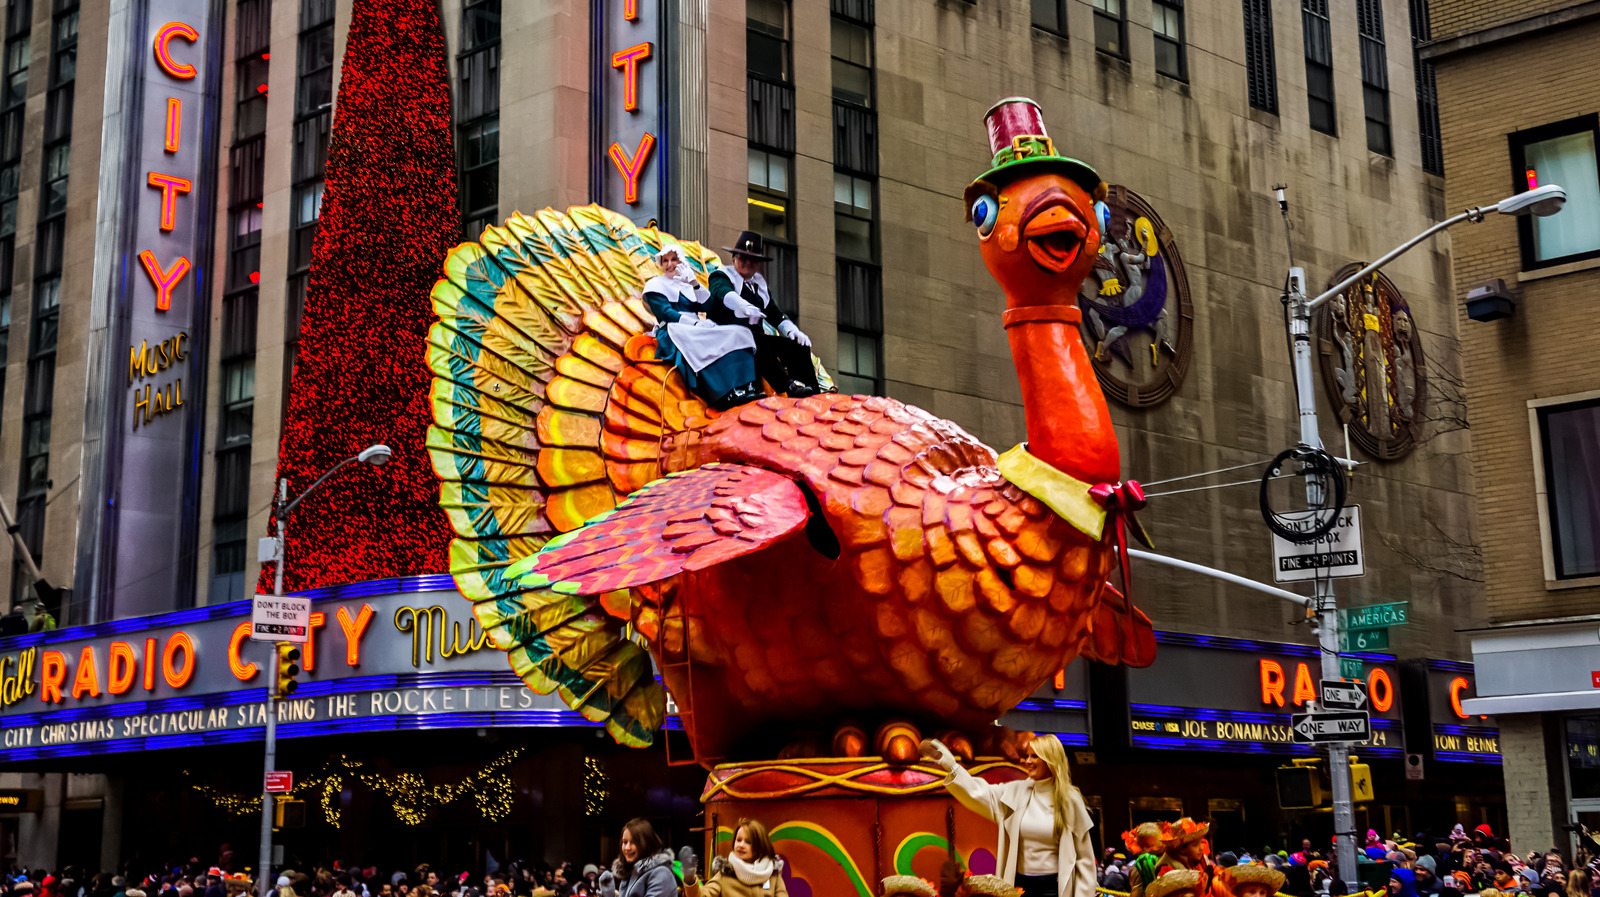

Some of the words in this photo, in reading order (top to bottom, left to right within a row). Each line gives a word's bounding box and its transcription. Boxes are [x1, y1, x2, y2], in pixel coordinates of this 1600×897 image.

[138, 21, 200, 311] CITY
[1281, 558, 1302, 570] FINE
[1321, 552, 1355, 566] POINTS
[257, 601, 279, 609] DON'T
[281, 602, 306, 611] BLOCK
[266, 610, 280, 619] THE
[282, 612, 298, 620] BOX
[1351, 609, 1406, 627] AMERICAS
[1357, 633, 1367, 648] 6
[41, 631, 195, 703] RADIO
[1326, 690, 1341, 701] ONE
[1347, 693, 1362, 702] WAY
[5, 727, 34, 748] CITY
[40, 719, 115, 745] CHRISTMAS
[122, 708, 228, 737] SPECTACULAR
[237, 698, 316, 726] STARING
[328, 694, 358, 718] THE
[371, 686, 532, 714] ROCKETTES
[1181, 719, 1208, 738] JOE
[1372, 730, 1387, 746] 24
[1300, 722, 1325, 734] ONE
[1337, 720, 1362, 732] WAY
[1434, 734, 1460, 750] TONY
